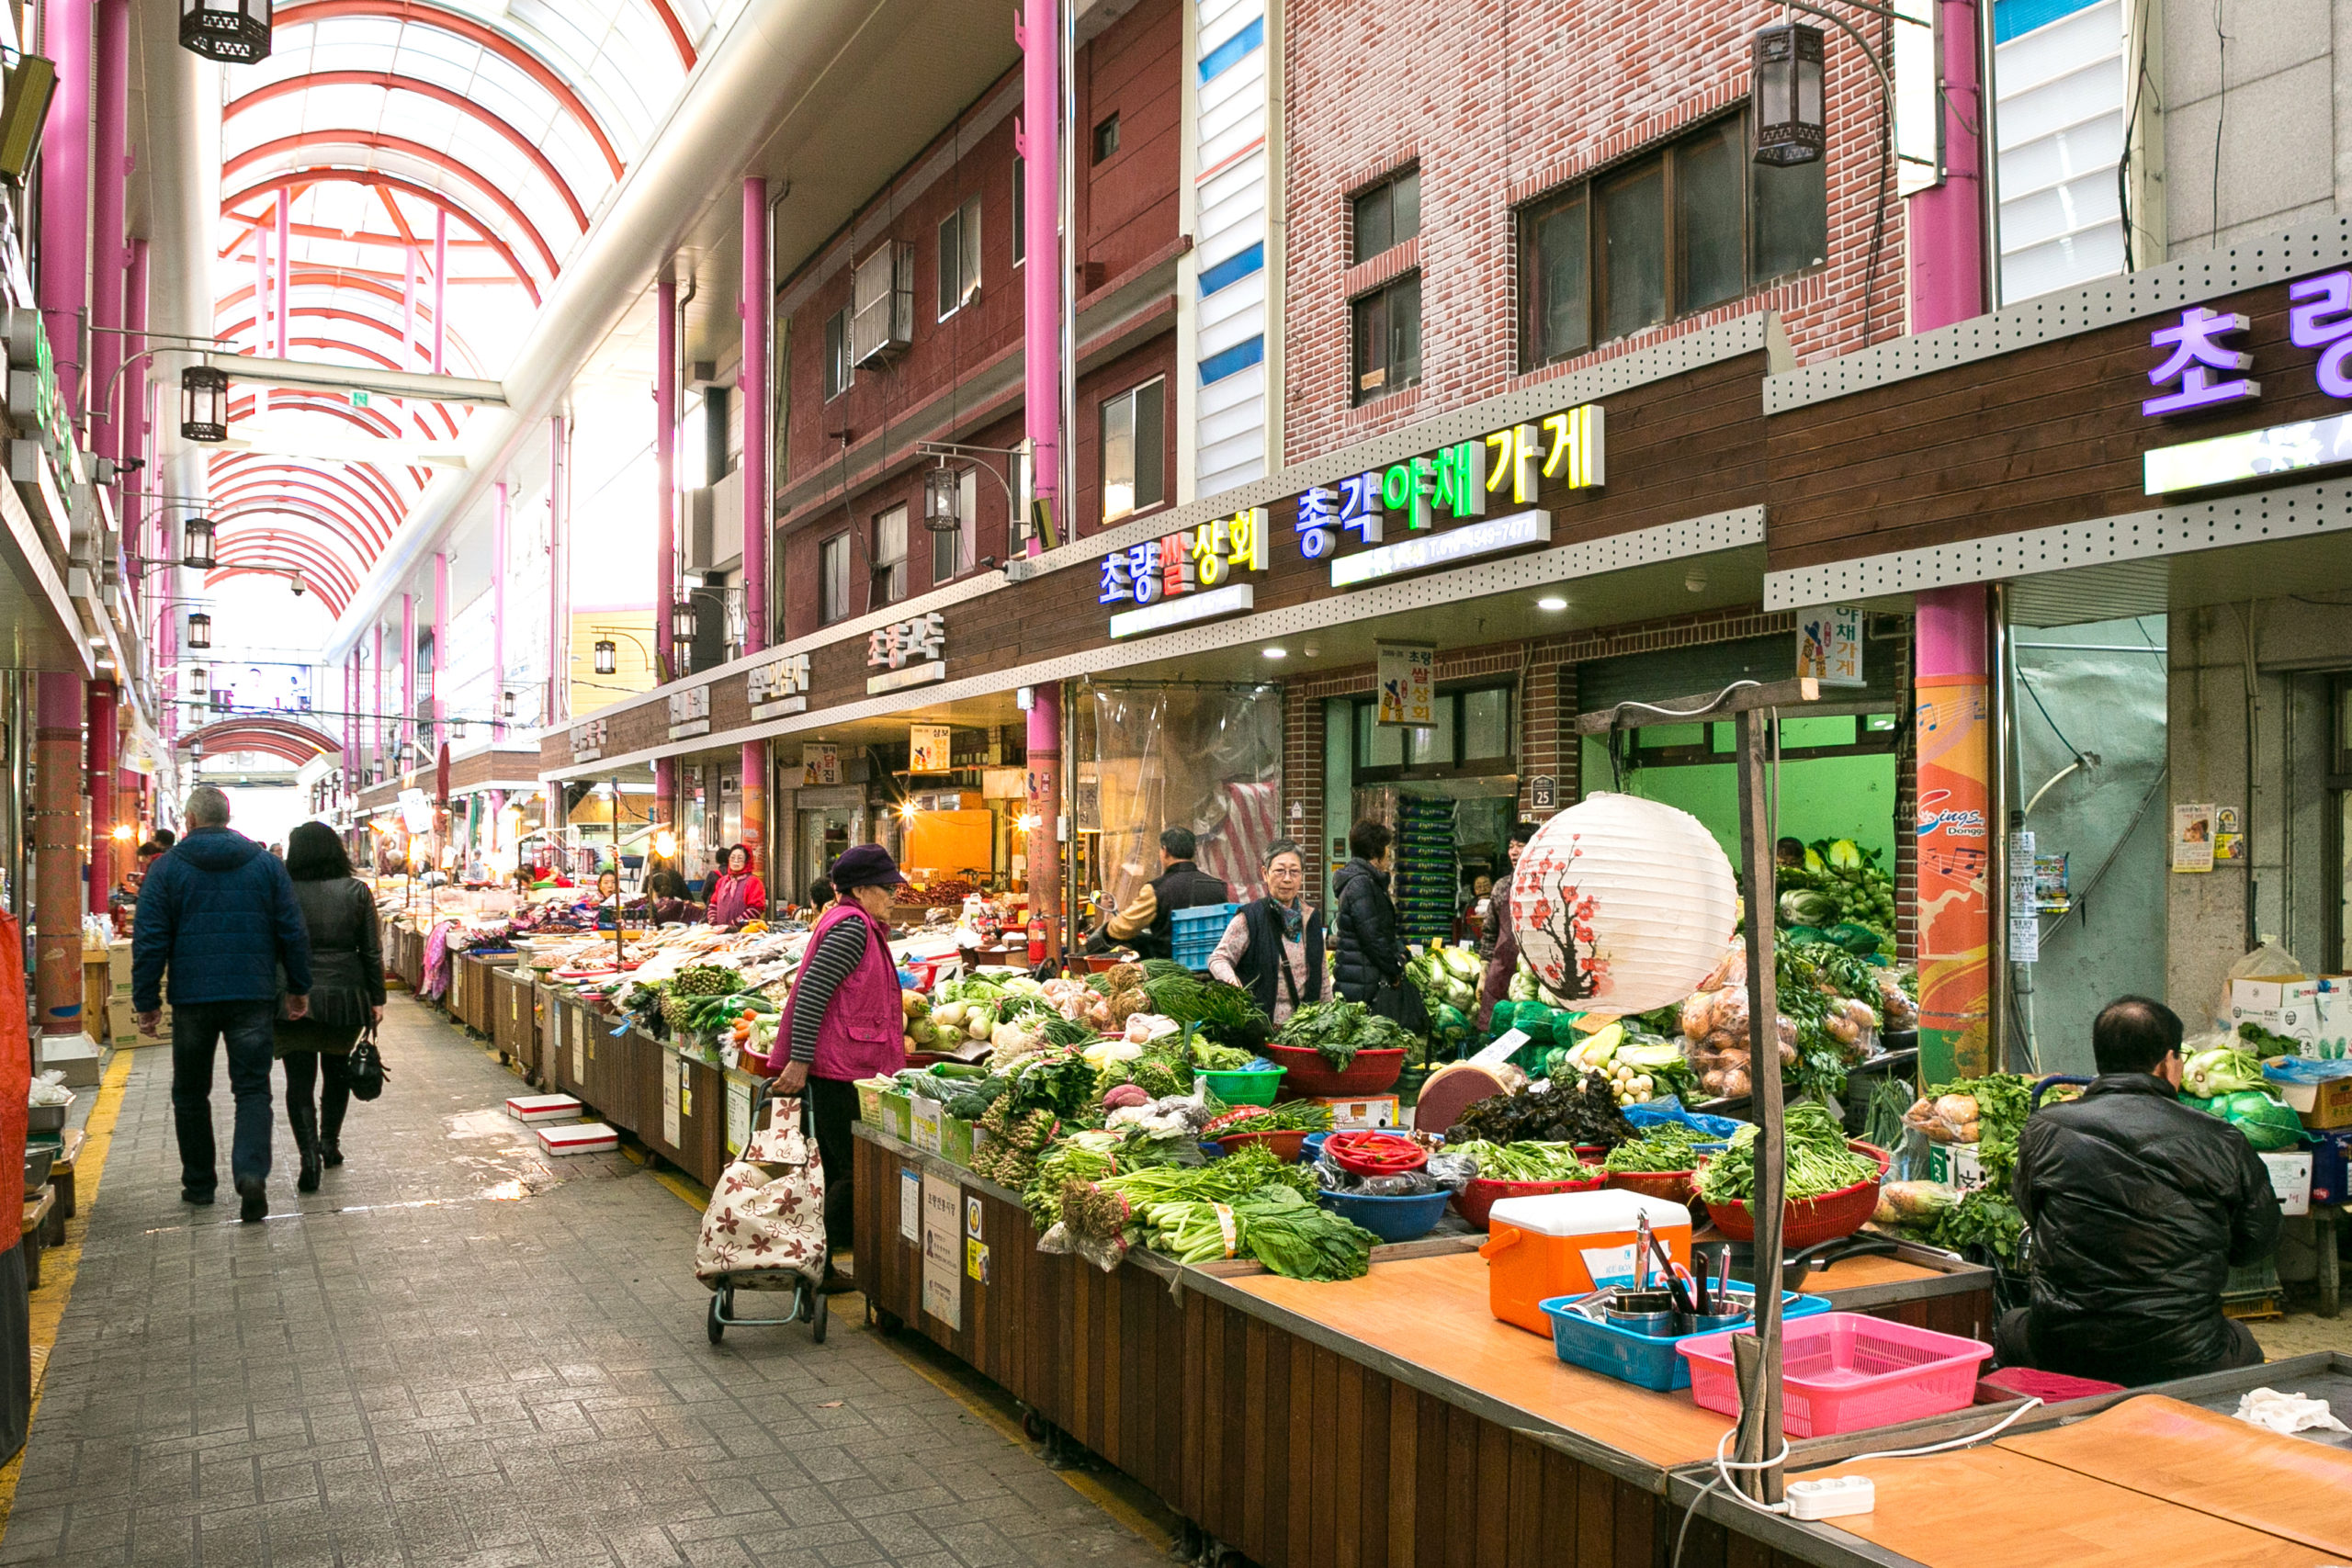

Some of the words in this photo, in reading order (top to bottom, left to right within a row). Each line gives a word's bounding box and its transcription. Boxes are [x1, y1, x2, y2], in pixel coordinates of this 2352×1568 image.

[1295, 404, 1600, 559] 총각야채가게
[1099, 507, 1264, 604] 초량쌀상회
[1408, 650, 1432, 666] 초량
[933, 728, 949, 738] 삼보
[1536, 791, 1550, 805] 25
[1605, 1266, 1616, 1275] ICE
